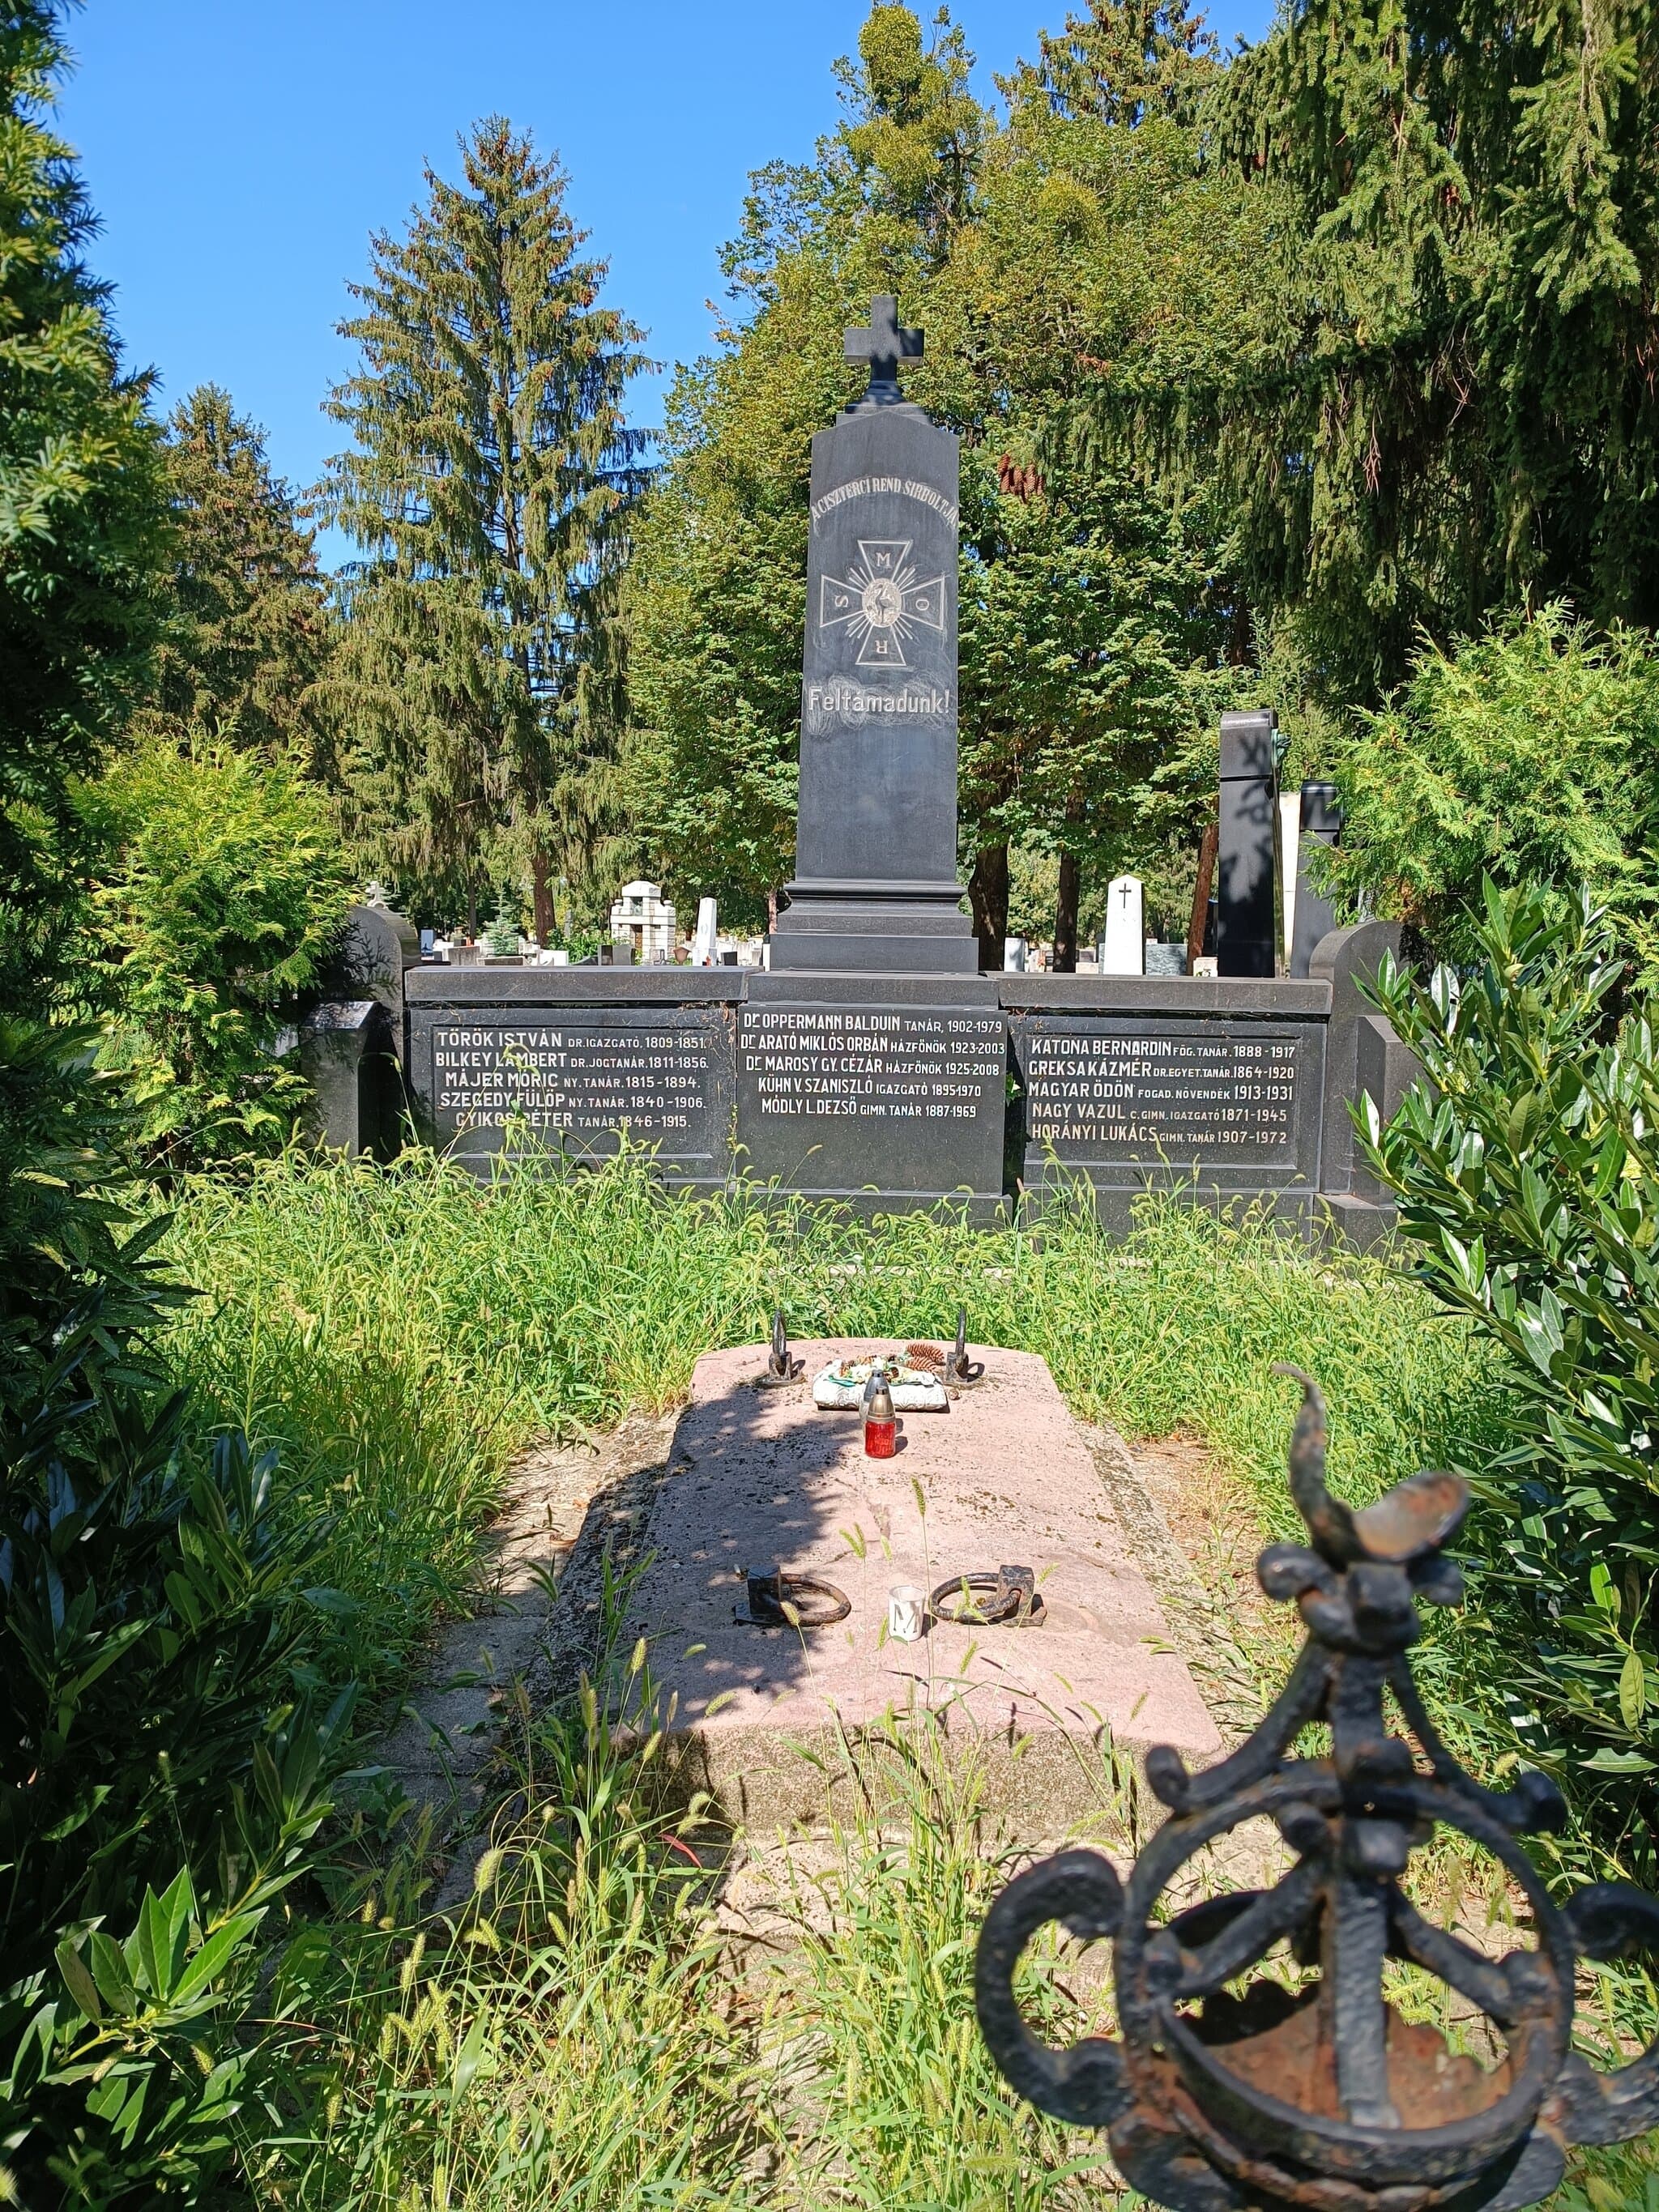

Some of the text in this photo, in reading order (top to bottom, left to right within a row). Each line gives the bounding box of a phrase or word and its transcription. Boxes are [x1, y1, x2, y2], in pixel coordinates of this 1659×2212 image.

[811, 505, 821, 521] A
[817, 479, 871, 514] CISZTERCI
[872, 478, 902, 493] REND
[876, 552, 891, 567] M
[808, 686, 950, 714] Feltámadunk!
[762, 1014, 842, 1030] OPPERMANN
[845, 1015, 900, 1032] BALDUIN
[904, 1018, 945, 1034] TANÁR,
[947, 1020, 1003, 1034] 1902-1979
[498, 1029, 562, 1047] ISTVÁN
[758, 1031, 797, 1051] ARATÓ
[800, 1031, 845, 1051] MIKLÓS
[847, 1033, 889, 1052] ORBÁN
[950, 1042, 1005, 1055] 1923-2003
[1031, 1039, 1090, 1055] KATONA
[1093, 1040, 1171, 1057] BERNARDIN
[436, 1052, 493, 1068] BILKEY
[496, 1052, 567, 1068] LAMBERT
[765, 1056, 818, 1072] MAROSY
[821, 1057, 838, 1072] GY.
[840, 1054, 883, 1073] CÉZÁR
[945, 1062, 1000, 1076] 1925-2008
[1028, 1060, 1086, 1076] GREKSA
[1087, 1057, 1152, 1077] KÁZMÉR
[446, 1068, 504, 1087] MÁJER
[507, 1068, 559, 1088] MÓRIC
[563, 1077, 582, 1089] NY.
[758, 1073, 791, 1093] KÜHN
[804, 1075, 873, 1093] SZANISZLÓ
[876, 1081, 928, 1096] IGAZGATÓ
[932, 1084, 982, 1097] 1895-1970
[440, 1092, 513, 1107] SZEGEDY
[568, 1097, 587, 1108] NY.
[1028, 1081, 1090, 1097] MAGYAR
[1093, 1079, 1133, 1098] ÖDÖN
[1234, 1085, 1294, 1101] 1913-1931
[761, 1094, 804, 1114] MÓDLY
[859, 1105, 887, 1116] GIMN.
[889, 1102, 923, 1117] TANÁR
[925, 1105, 976, 1118] 1887-1969
[1032, 1102, 1073, 1118] NAGY
[1077, 1103, 1126, 1119] VAZUL
[1170, 1107, 1220, 1121] IGAZGATÓ
[1220, 1108, 1287, 1122] 1871-1945
[1032, 1119, 1287, 1144] HORÁNYI LUKÁCS GIMN. TANÁR 1907-1972
